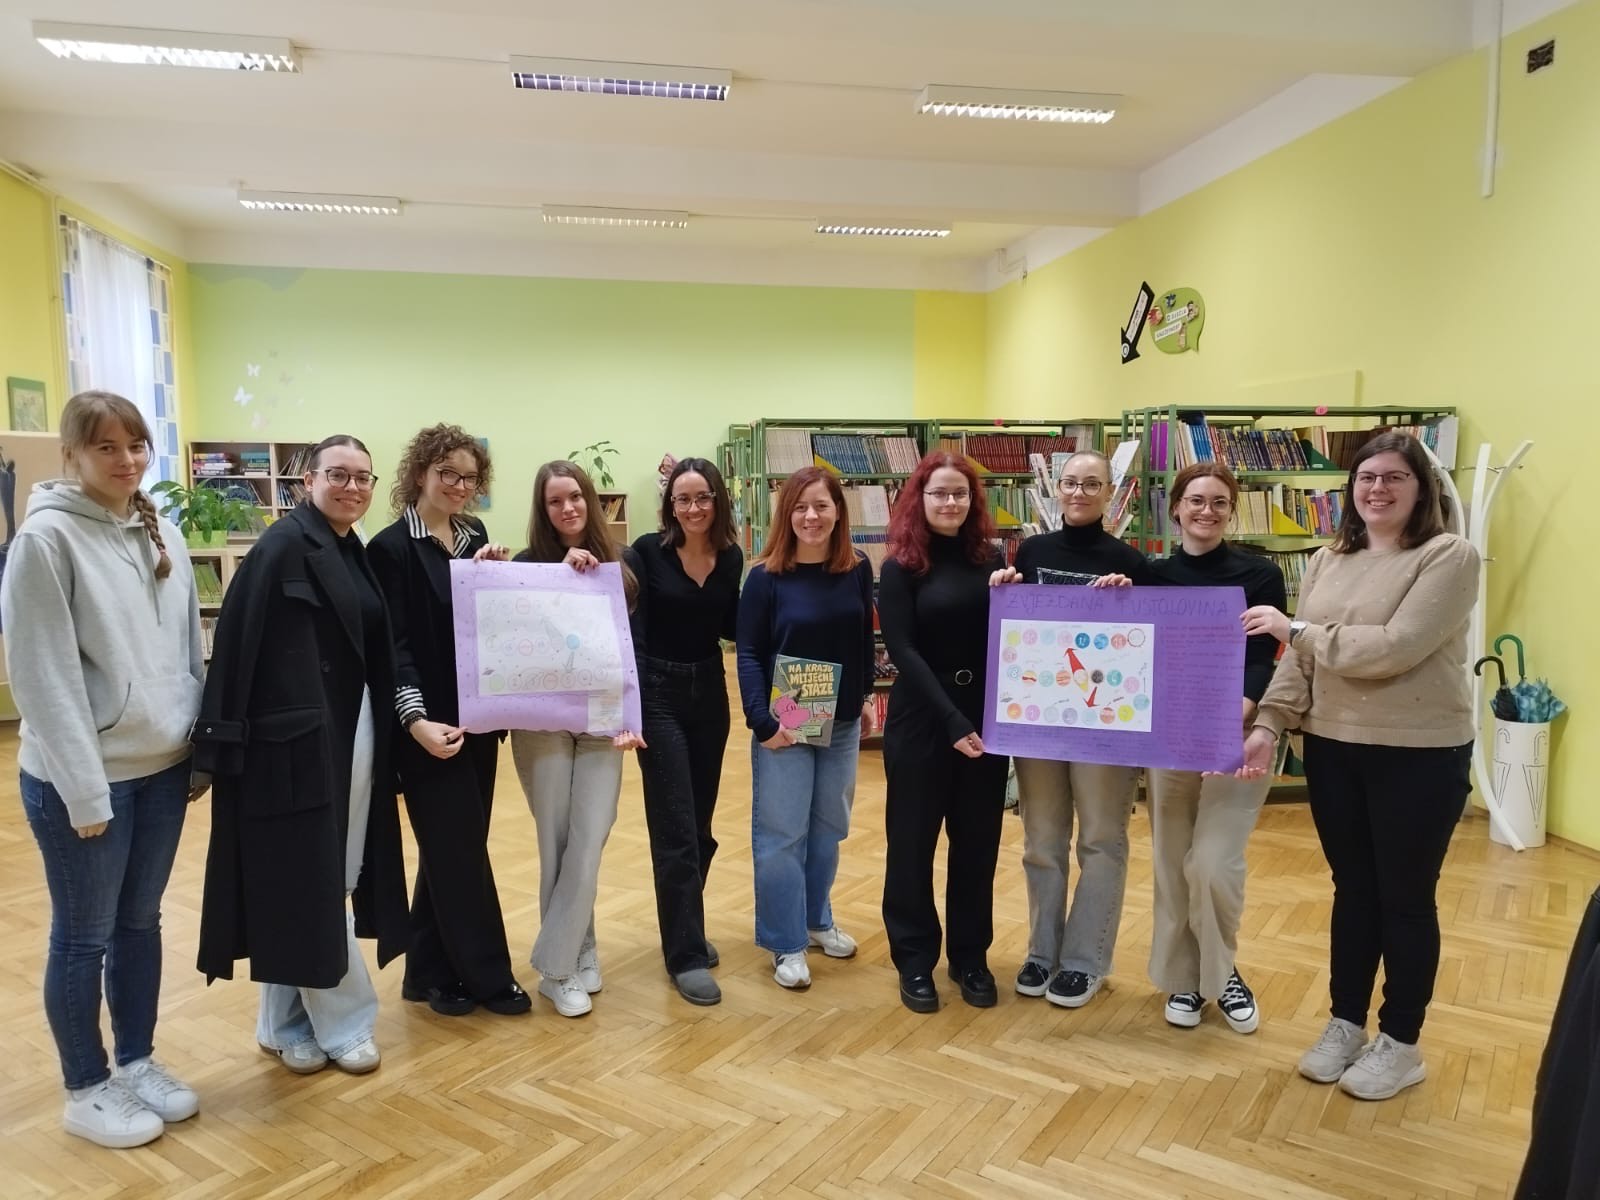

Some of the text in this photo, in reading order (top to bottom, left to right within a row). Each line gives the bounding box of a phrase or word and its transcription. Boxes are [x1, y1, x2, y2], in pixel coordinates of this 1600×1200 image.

[1006, 592, 1228, 617] ZVJEZDANA PUSTOLOVINA
[787, 663, 834, 673] NA KRAJU
[801, 682, 834, 697] STAZE
